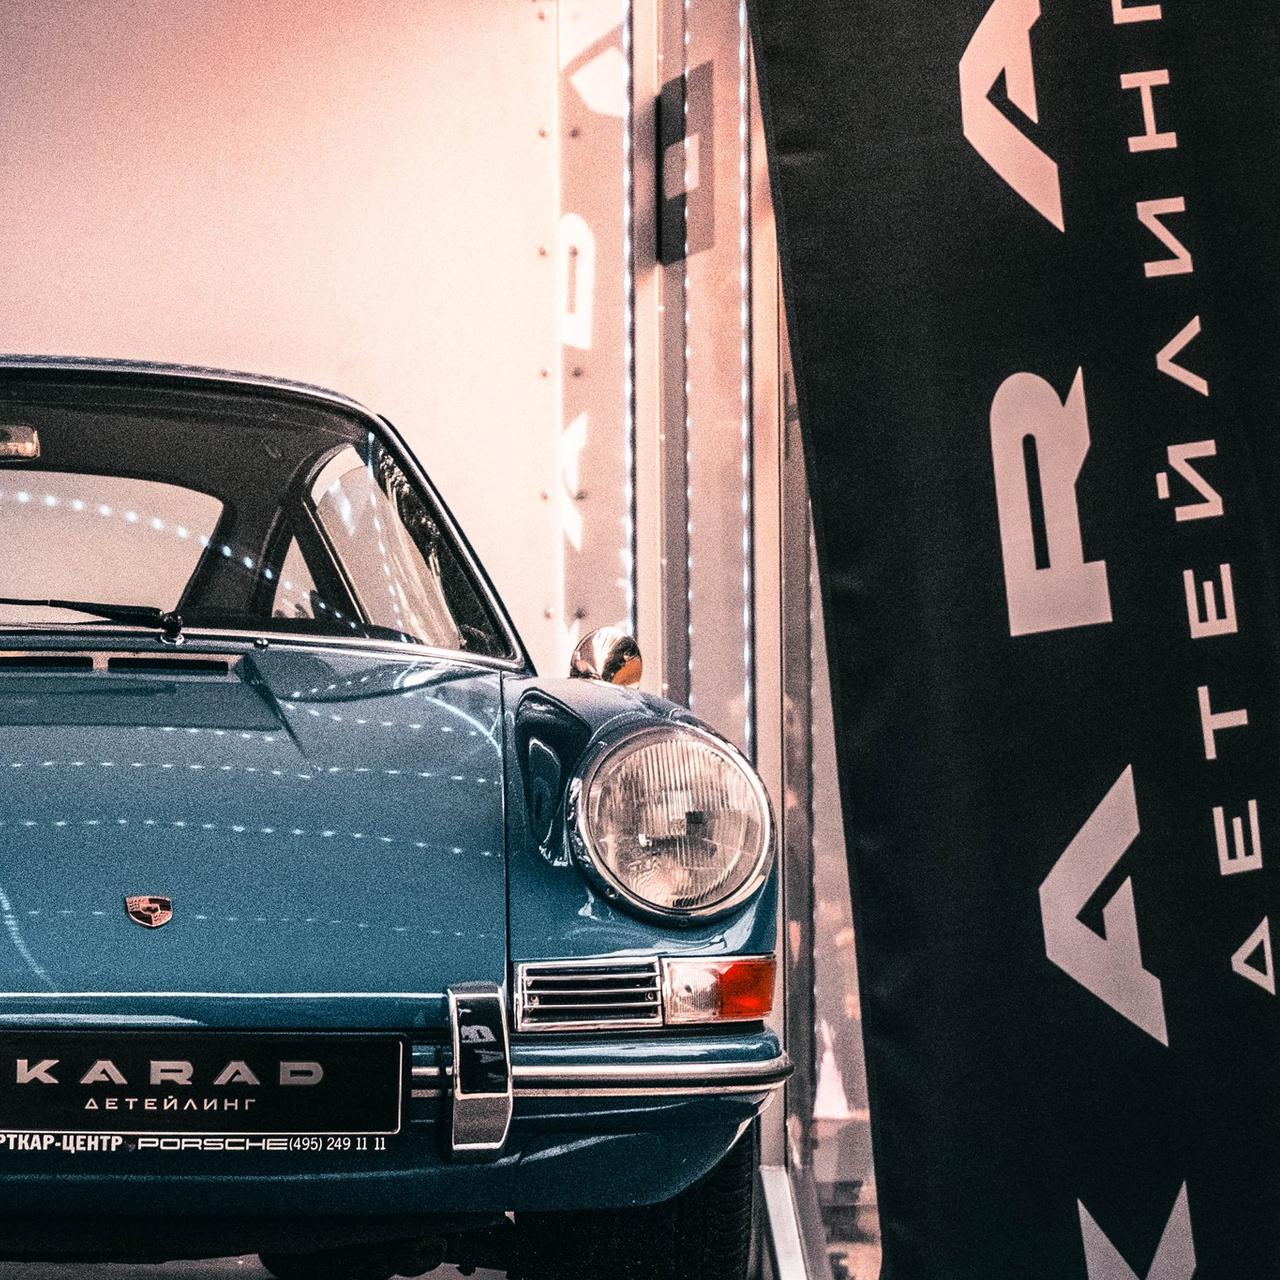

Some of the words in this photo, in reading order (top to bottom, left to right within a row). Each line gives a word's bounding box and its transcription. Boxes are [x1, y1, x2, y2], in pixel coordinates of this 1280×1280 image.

[16, 1058, 324, 1086] KARAD
[84, 1094, 256, 1111] ДЕТЕЙЛИНГ
[137, 1137, 288, 1151] PORSCHE
[289, 1136, 323, 1152] (495)
[326, 1136, 352, 1151] 249
[355, 1136, 368, 1151] 11
[374, 1136, 386, 1151] 11
